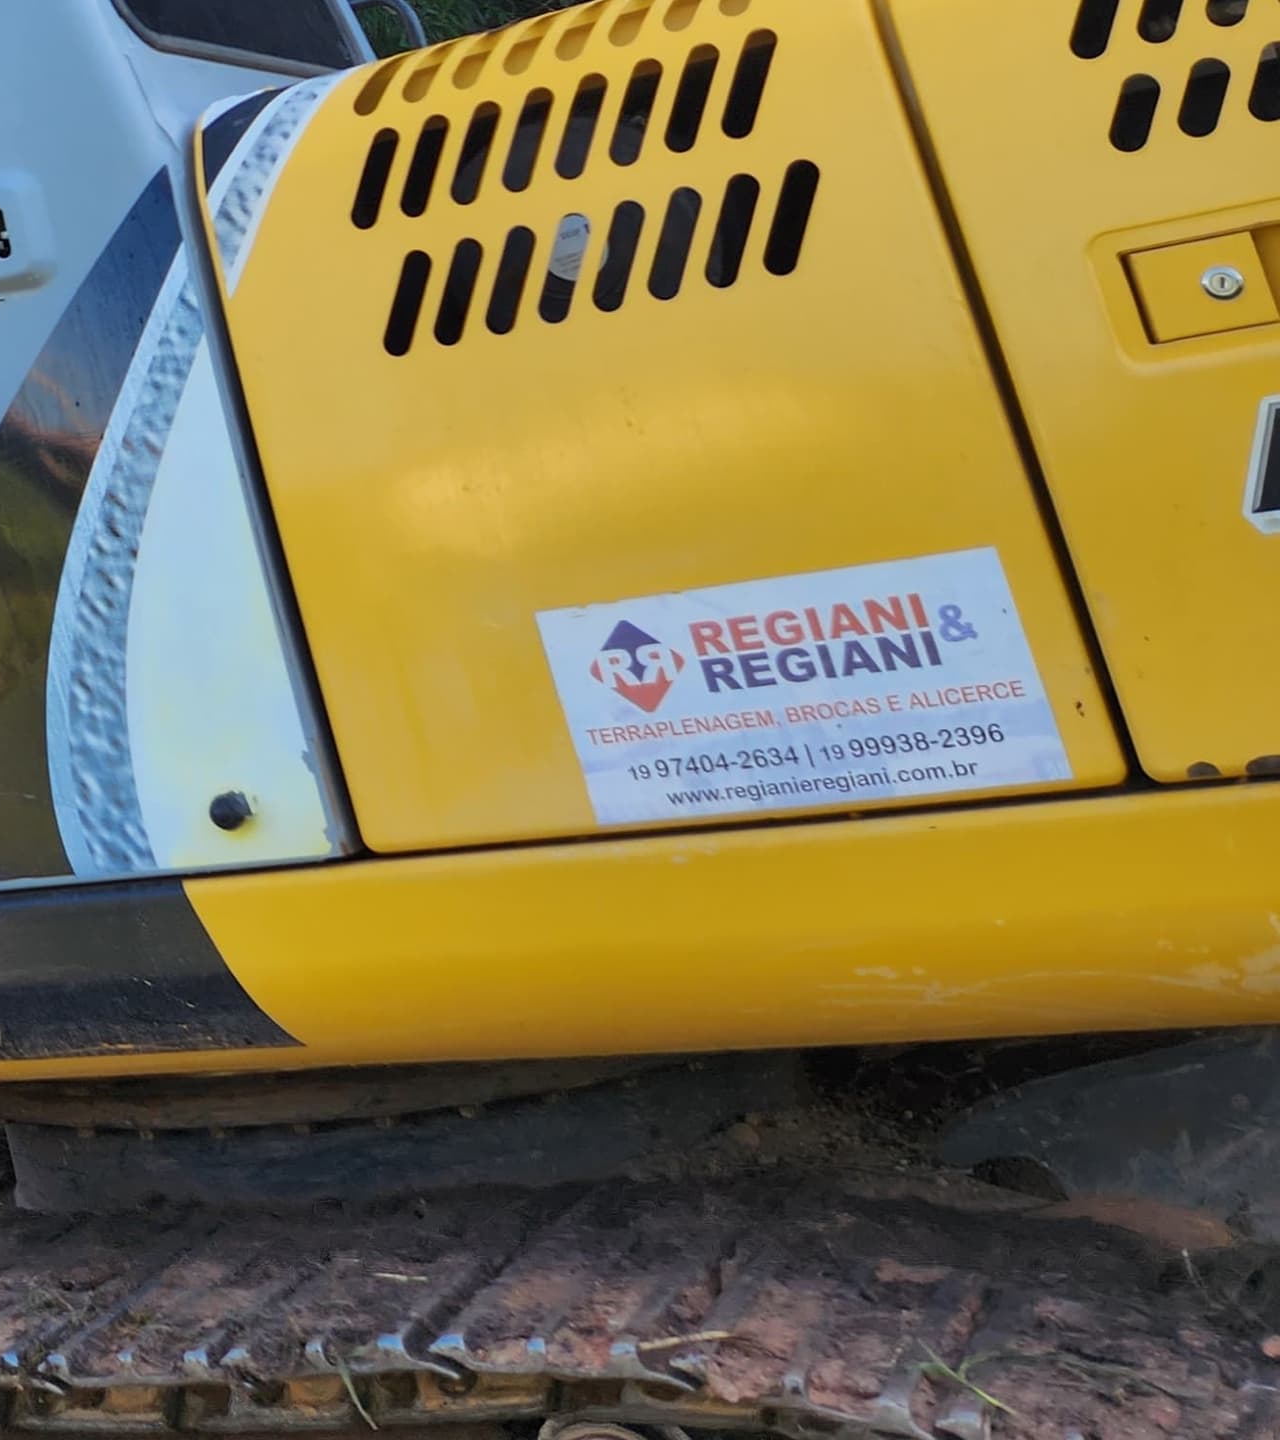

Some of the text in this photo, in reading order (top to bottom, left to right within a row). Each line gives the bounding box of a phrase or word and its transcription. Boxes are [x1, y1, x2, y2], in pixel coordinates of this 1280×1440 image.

[688, 592, 979, 657] REGIANI &
[699, 631, 943, 694] REGIANI
[586, 680, 1027, 746] TERRAPLENAGEM, BROCAS E ALICERCE
[628, 764, 652, 782] 19
[655, 745, 799, 778] 97404-2634
[820, 743, 845, 762] 19
[848, 722, 1005, 759] 99938-2396
[666, 760, 979, 805] www.regianieregiani.com.br
